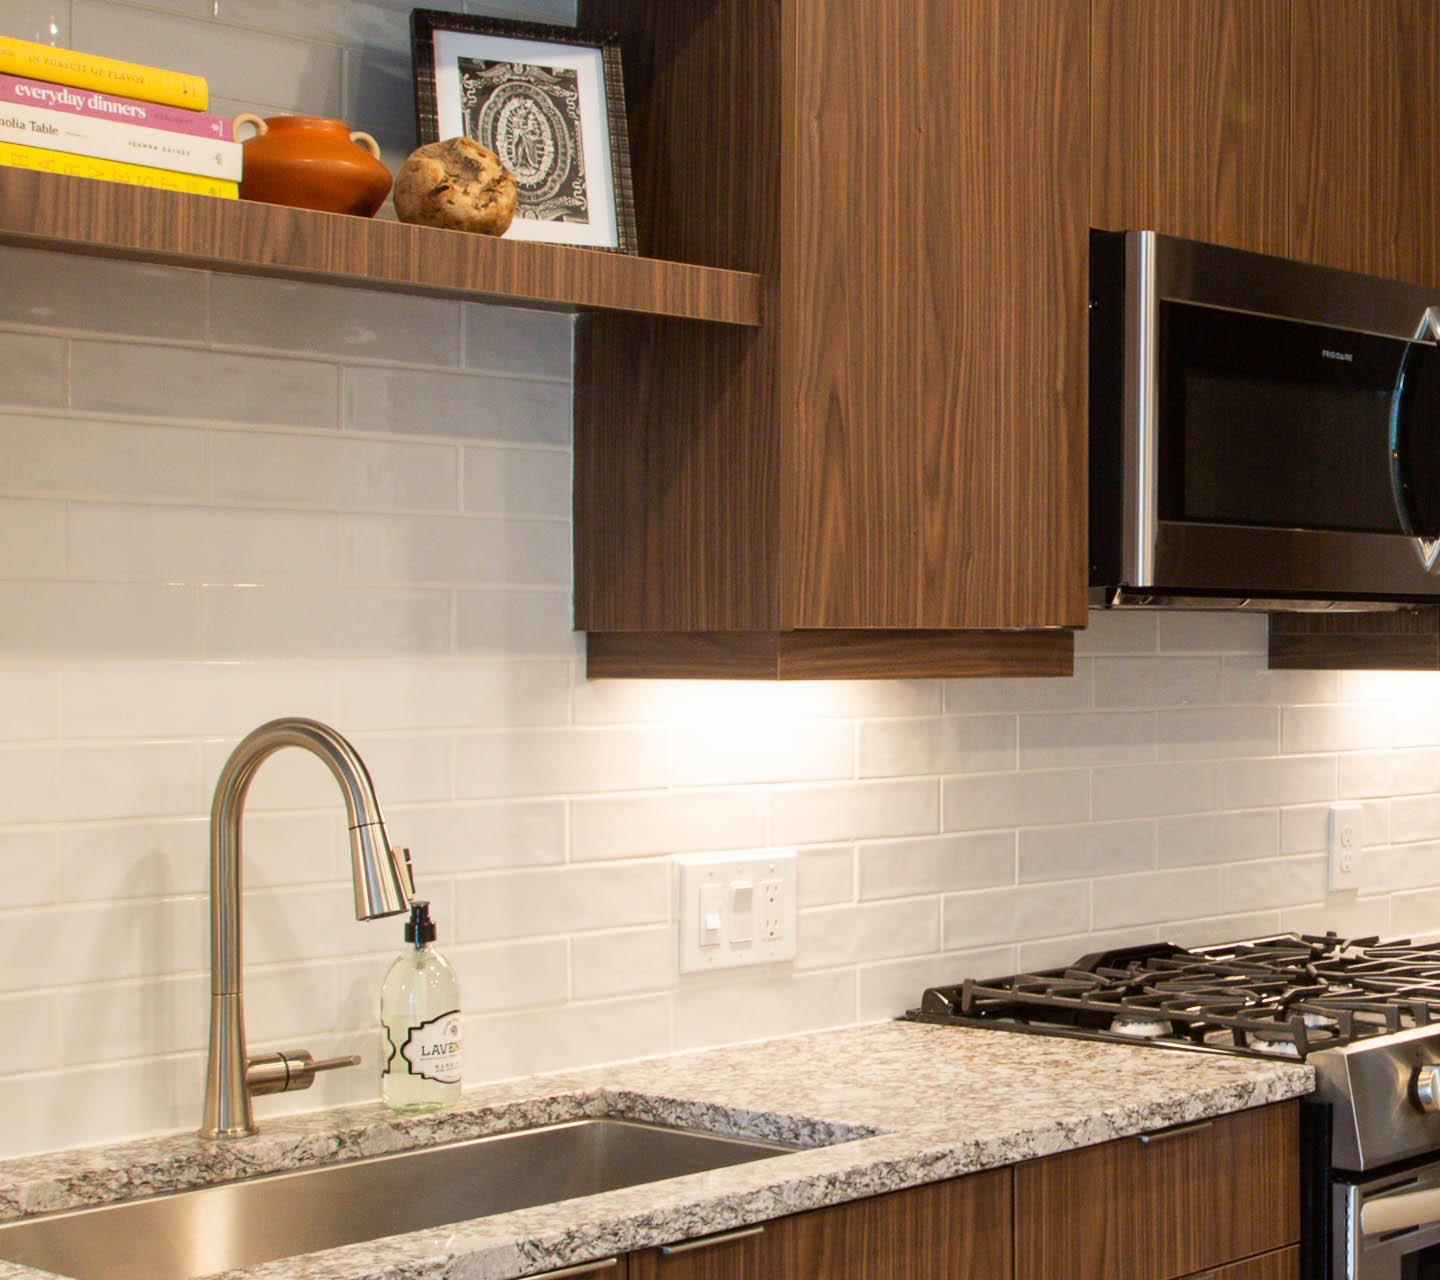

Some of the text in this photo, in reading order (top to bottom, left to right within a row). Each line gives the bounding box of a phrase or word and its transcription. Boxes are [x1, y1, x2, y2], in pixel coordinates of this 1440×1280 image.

[44, 57, 87, 73] PURSUIT
[90, 65, 105, 76] OF
[107, 68, 146, 83] FLAVOR
[14, 82, 86, 111] everyday
[87, 94, 147, 119] dinners
[29, 120, 59, 136] Table
